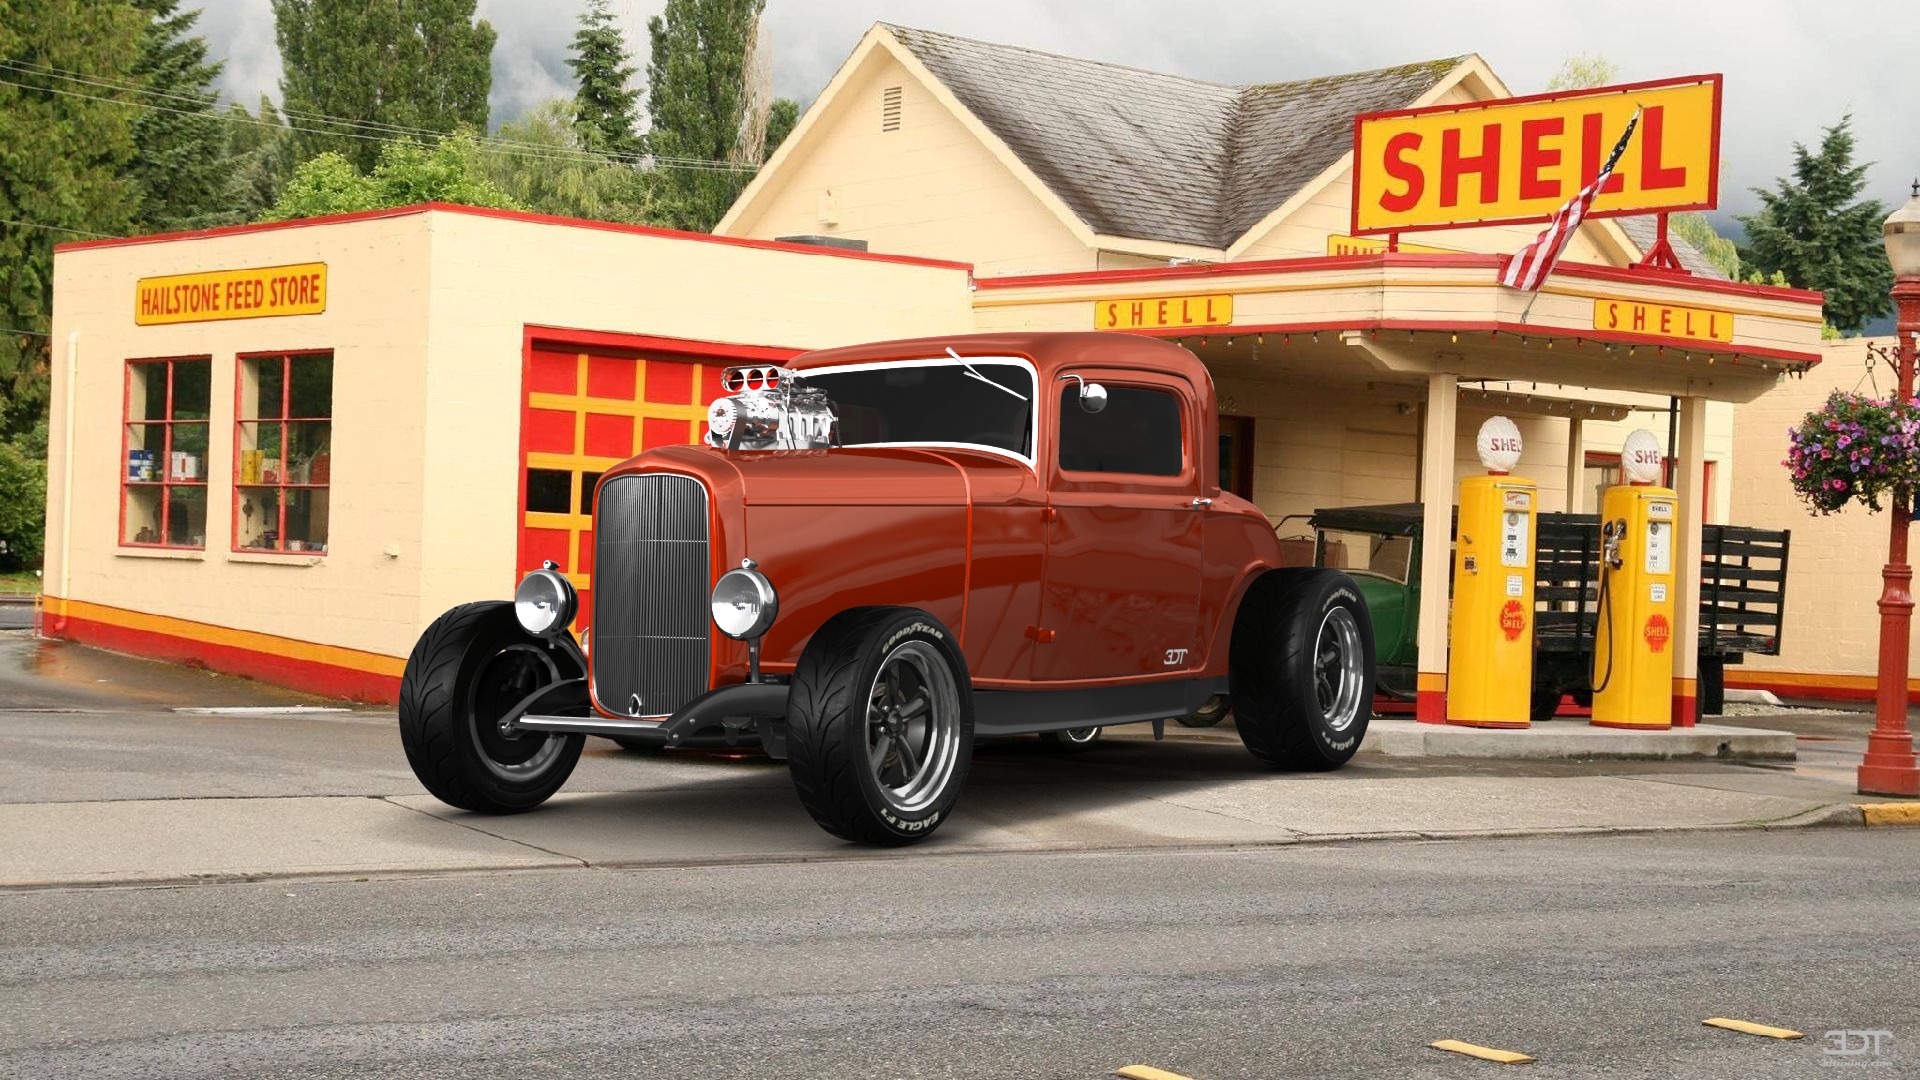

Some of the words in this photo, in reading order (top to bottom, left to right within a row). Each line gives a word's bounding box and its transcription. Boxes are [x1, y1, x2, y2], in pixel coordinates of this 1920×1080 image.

[1378, 104, 1687, 213] SHELL
[141, 283, 220, 315] HAILSTONE
[226, 280, 264, 310] FEED
[269, 274, 320, 306] STORE
[1108, 299, 1217, 327] SHELL
[1609, 303, 1718, 338] SHELL
[882, 622, 944, 653] GOODYEAR
[1646, 626, 1668, 637] SHELL
[880, 807, 897, 825] F1
[898, 810, 939, 831] EAGLE
